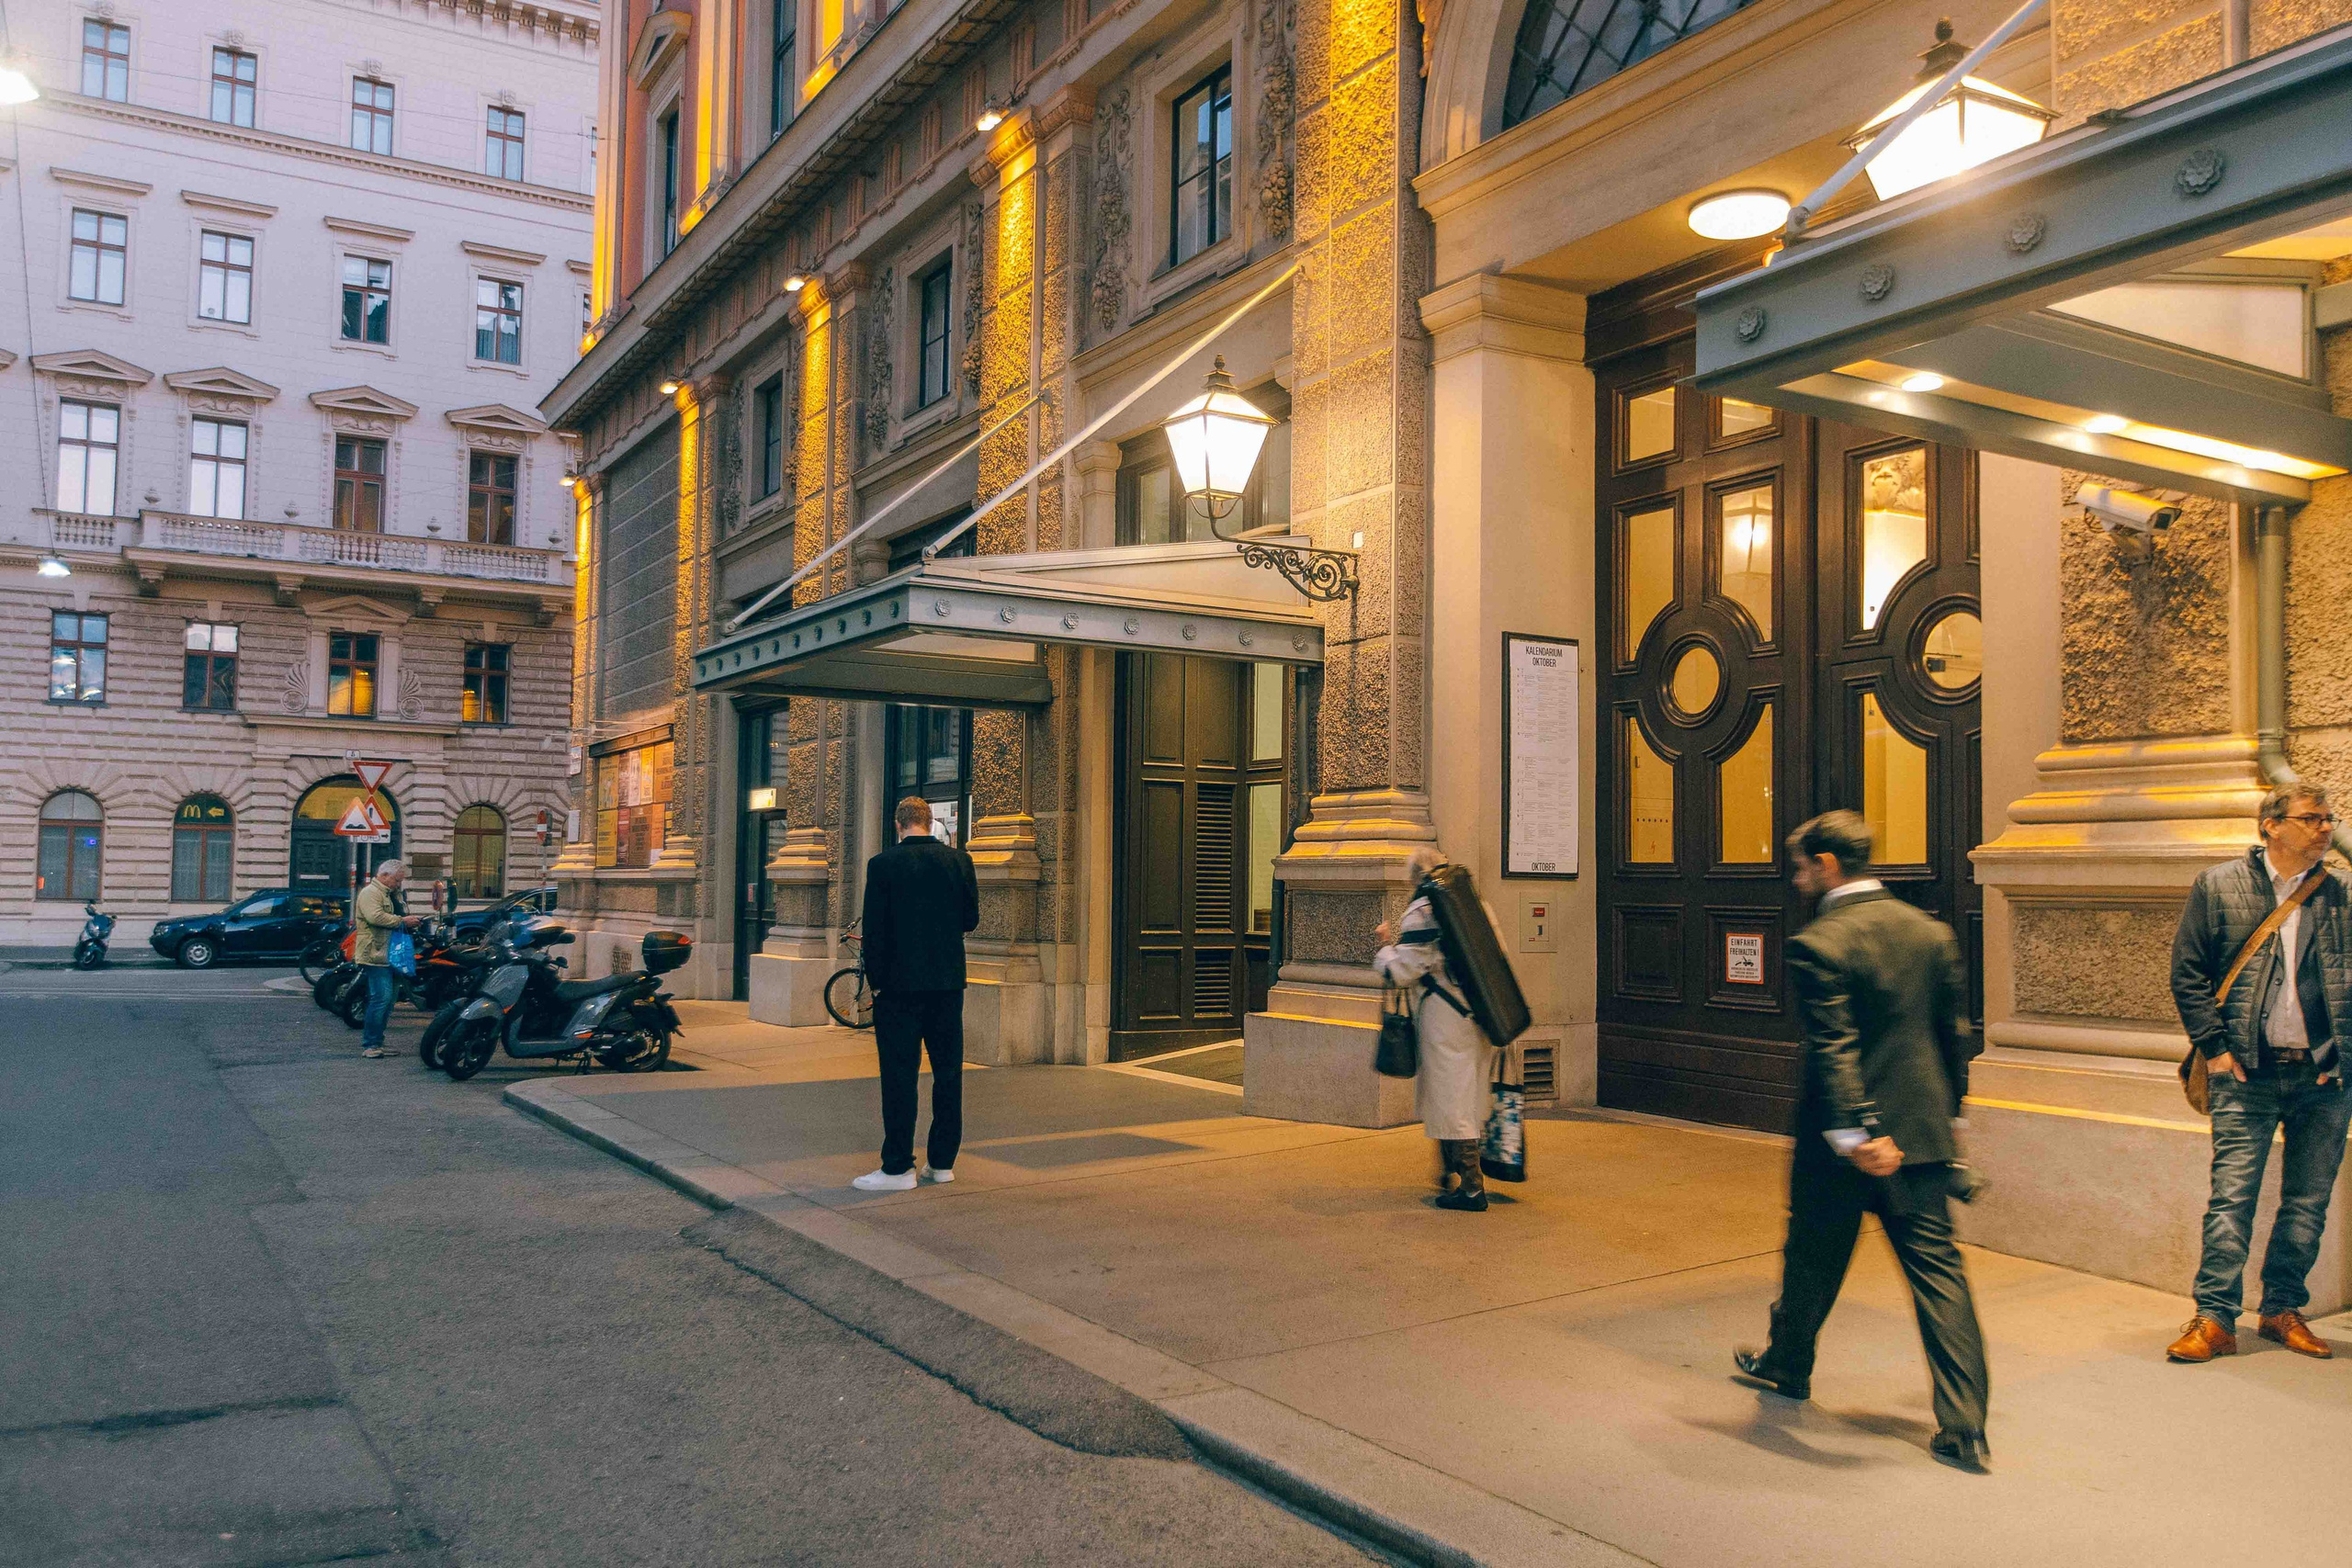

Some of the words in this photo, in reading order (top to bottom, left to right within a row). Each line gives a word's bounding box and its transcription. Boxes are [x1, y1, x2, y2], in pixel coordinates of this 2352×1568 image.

[1525, 646, 1563, 658] KALENDARIUM
[1532, 657, 1556, 668] OKTOBER
[1531, 862, 1556, 872] OKTOBER
[1730, 938, 1758, 947] EINFAHRT
